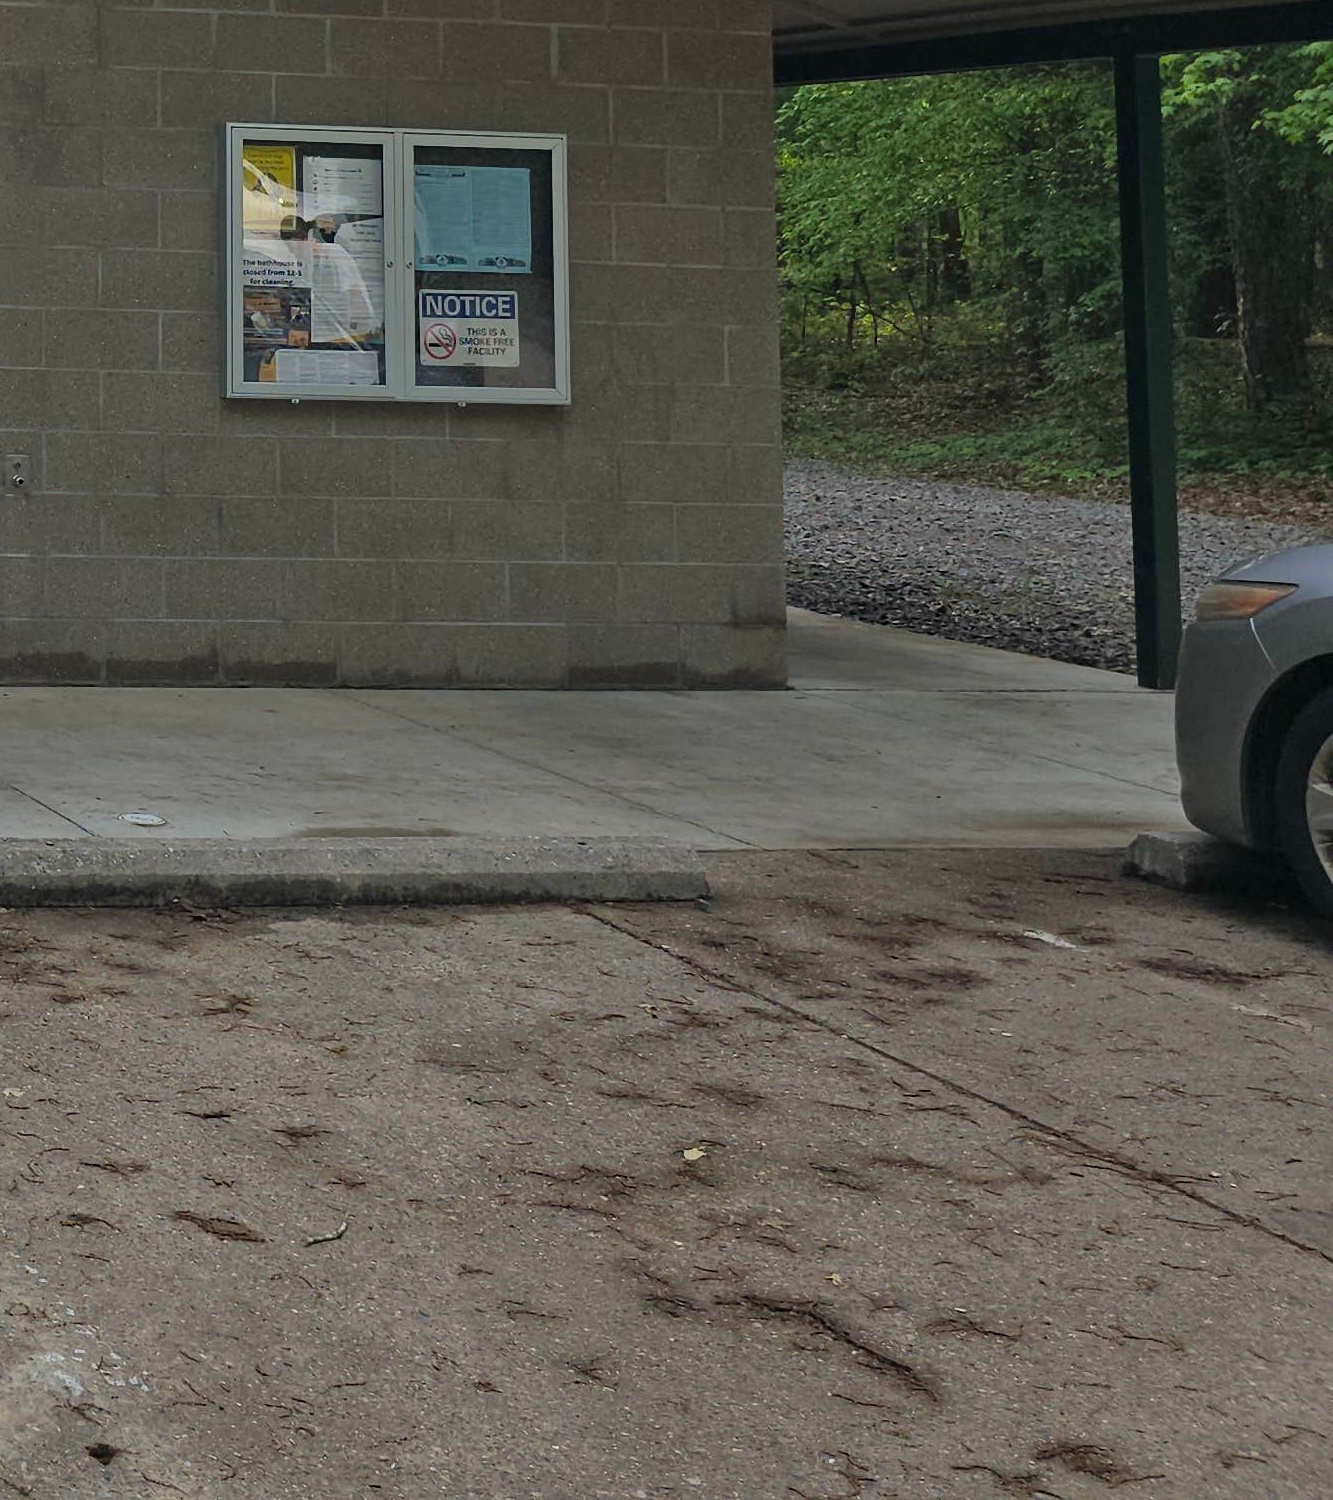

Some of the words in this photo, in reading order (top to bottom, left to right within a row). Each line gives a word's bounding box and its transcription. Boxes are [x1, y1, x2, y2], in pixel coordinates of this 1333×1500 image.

[262, 278, 294, 287] cleaning
[425, 295, 512, 317] NOTICE
[467, 327, 487, 336] THIS
[489, 327, 498, 336] IS
[499, 328, 507, 336] A
[459, 337, 492, 346] SMOKE
[493, 338, 516, 347] FREE
[468, 347, 506, 356] FACILITY
